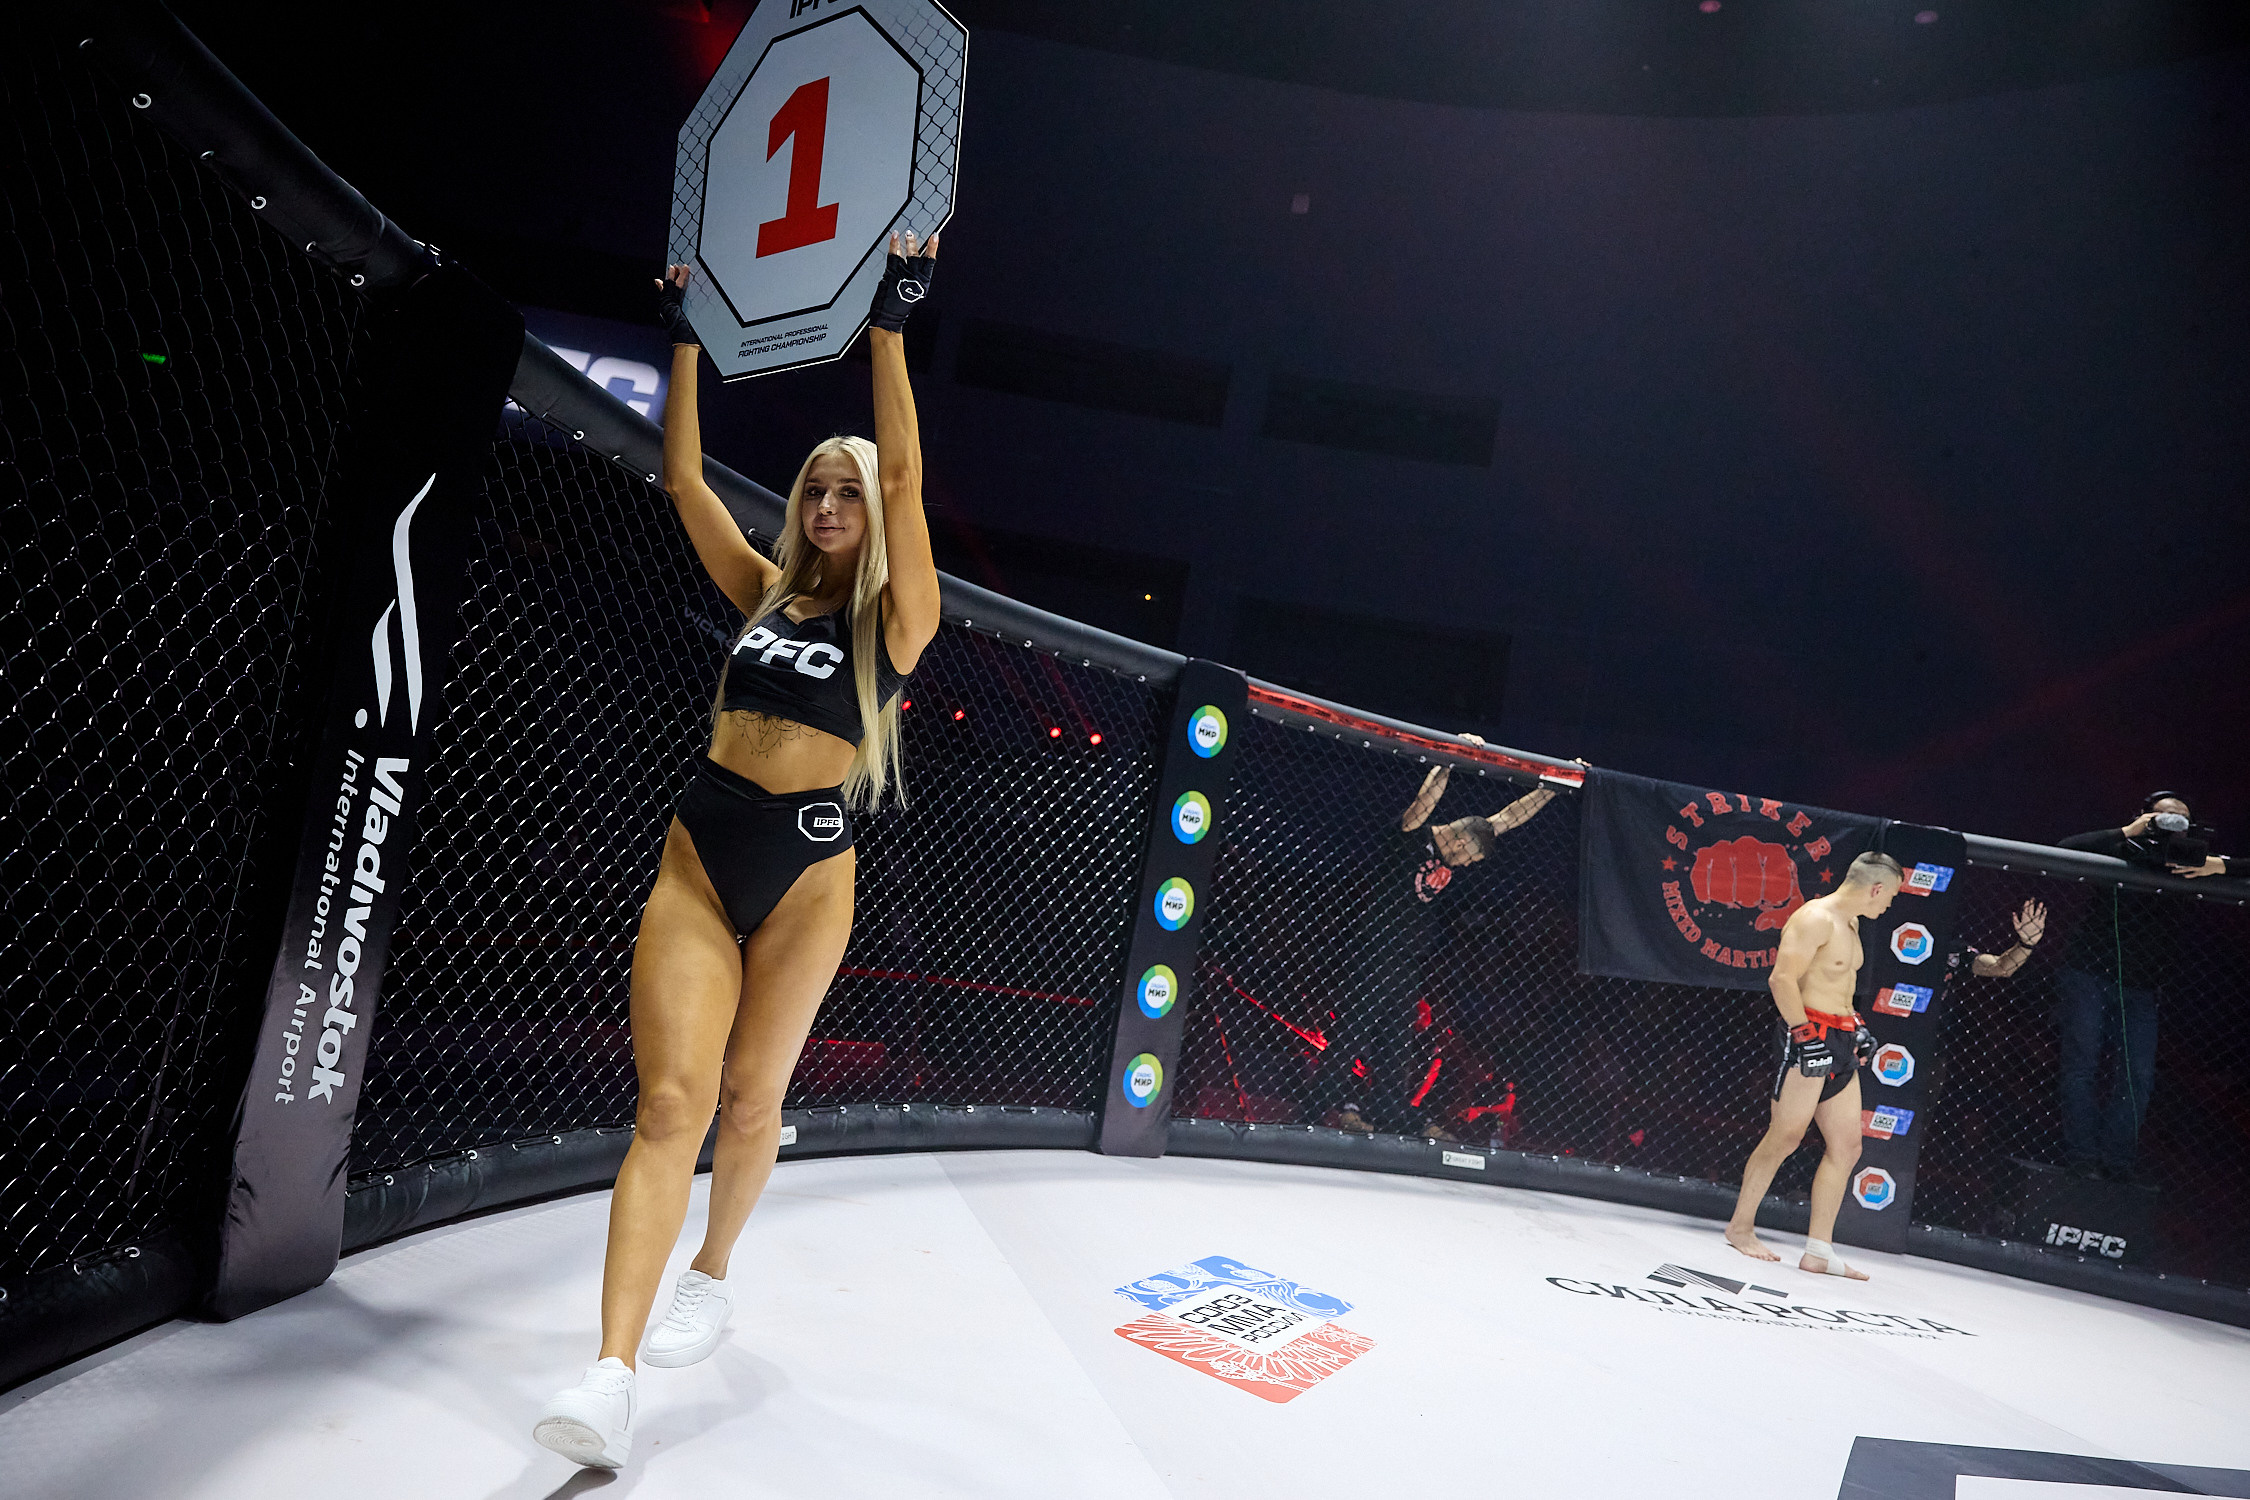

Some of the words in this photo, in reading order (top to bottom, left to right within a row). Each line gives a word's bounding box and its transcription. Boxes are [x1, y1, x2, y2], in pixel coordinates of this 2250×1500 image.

[789, 0, 851, 20] IP
[755, 76, 840, 259] 1
[738, 345, 770, 358] FIGHTING
[771, 333, 827, 351] CHAMPIONSHIP
[740, 333, 783, 348] INTERNATIONAL
[784, 323, 829, 338] PROFESSIONAL
[731, 625, 845, 679] PFC
[1198, 727, 1217, 739] МИР
[816, 817, 840, 826] IPFC
[1181, 813, 1201, 825] МИР
[1665, 791, 1832, 862] STRIKER
[304, 749, 365, 970] International
[1164, 899, 1184, 911] МИР
[308, 757, 410, 1105] Vladivostok
[1661, 880, 1702, 943] MIXED
[1700, 938, 1779, 968] MARTIA
[1147, 988, 1167, 999] МИР
[275, 982, 317, 1104] Airport
[1133, 1076, 1153, 1088] МИР
[2045, 1223, 2127, 1258] IPFC
[1178, 1293, 1253, 1324] СОЮЗ
[1208, 1303, 1286, 1336] ММА
[1545, 1277, 1757, 1316] СИЛА
[1746, 1300, 1978, 1337] РОСТА
[1240, 1311, 1309, 1343] РОССИИ
